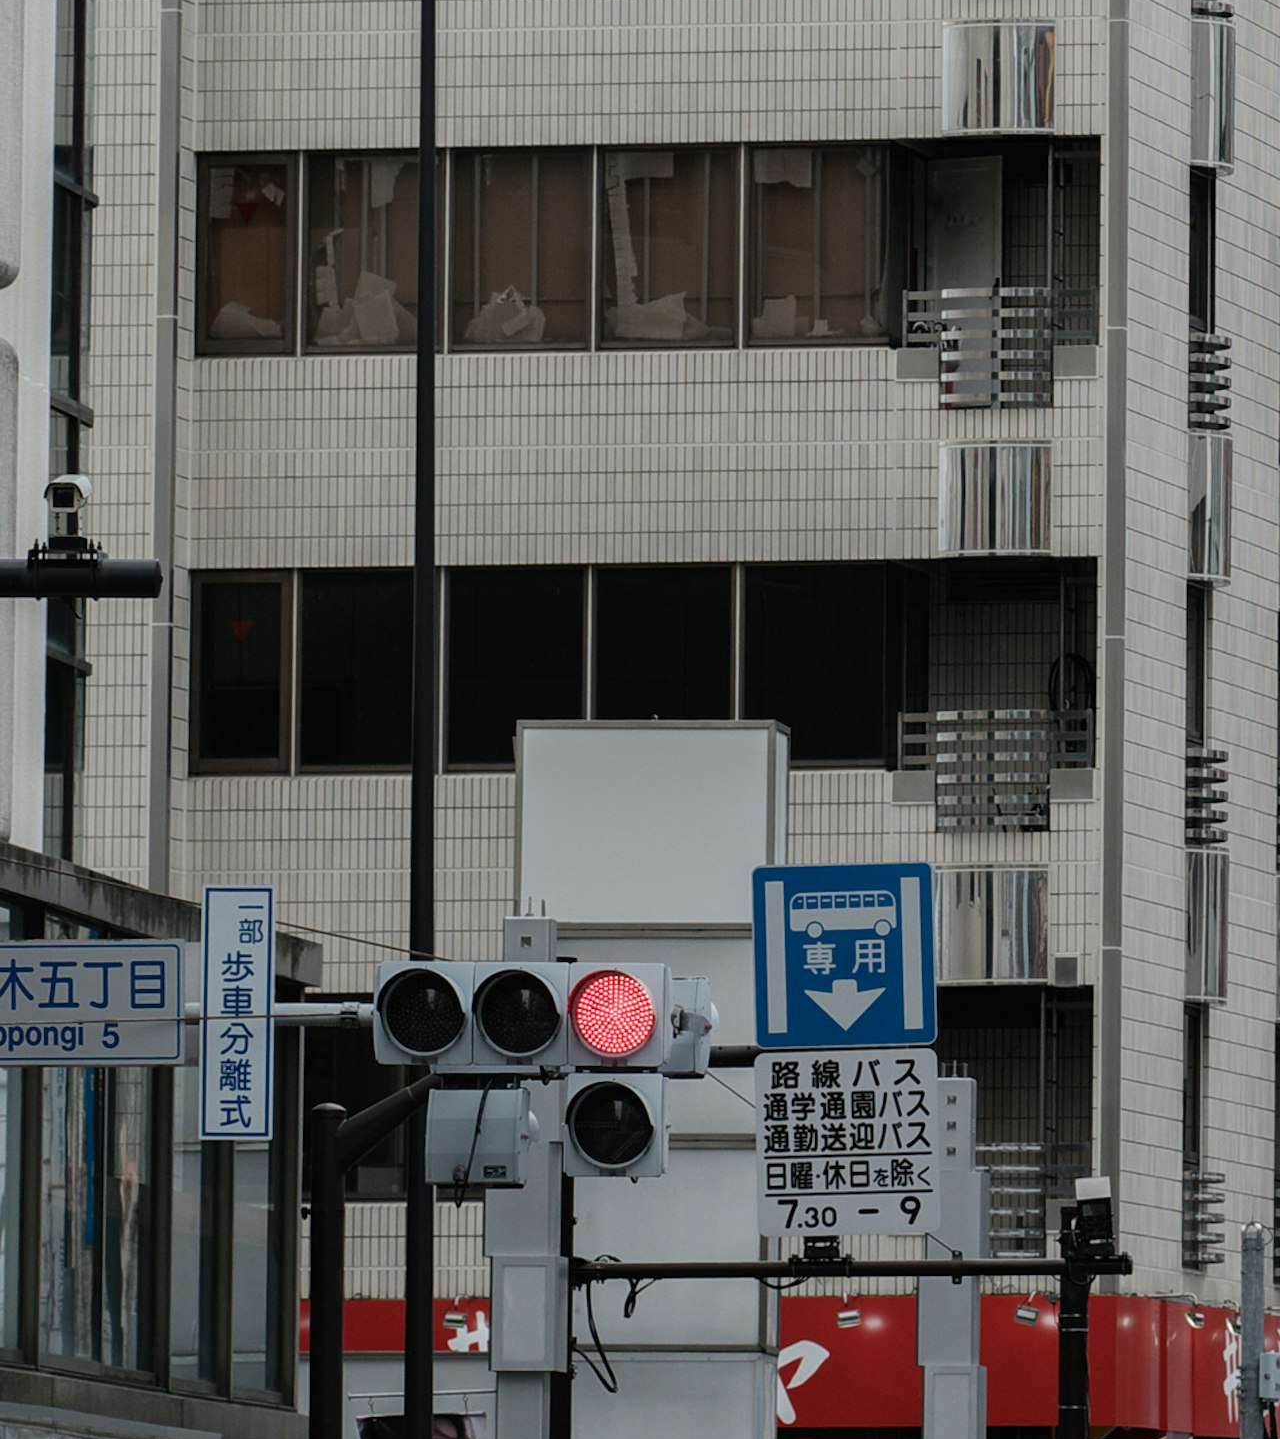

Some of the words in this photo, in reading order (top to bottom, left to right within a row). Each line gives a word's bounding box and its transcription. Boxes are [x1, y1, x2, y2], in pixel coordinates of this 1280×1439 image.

[238, 904, 265, 945] 一部
[803, 939, 886, 975] 専用
[102, 1024, 120, 1049] 5
[220, 951, 254, 1129] 歩車分離式
[771, 1059, 921, 1090] 路線バス
[763, 1090, 931, 1121] 通学通園バス
[763, 1122, 932, 1154] 通勤送迎バス
[900, 1196, 921, 1225] 9
